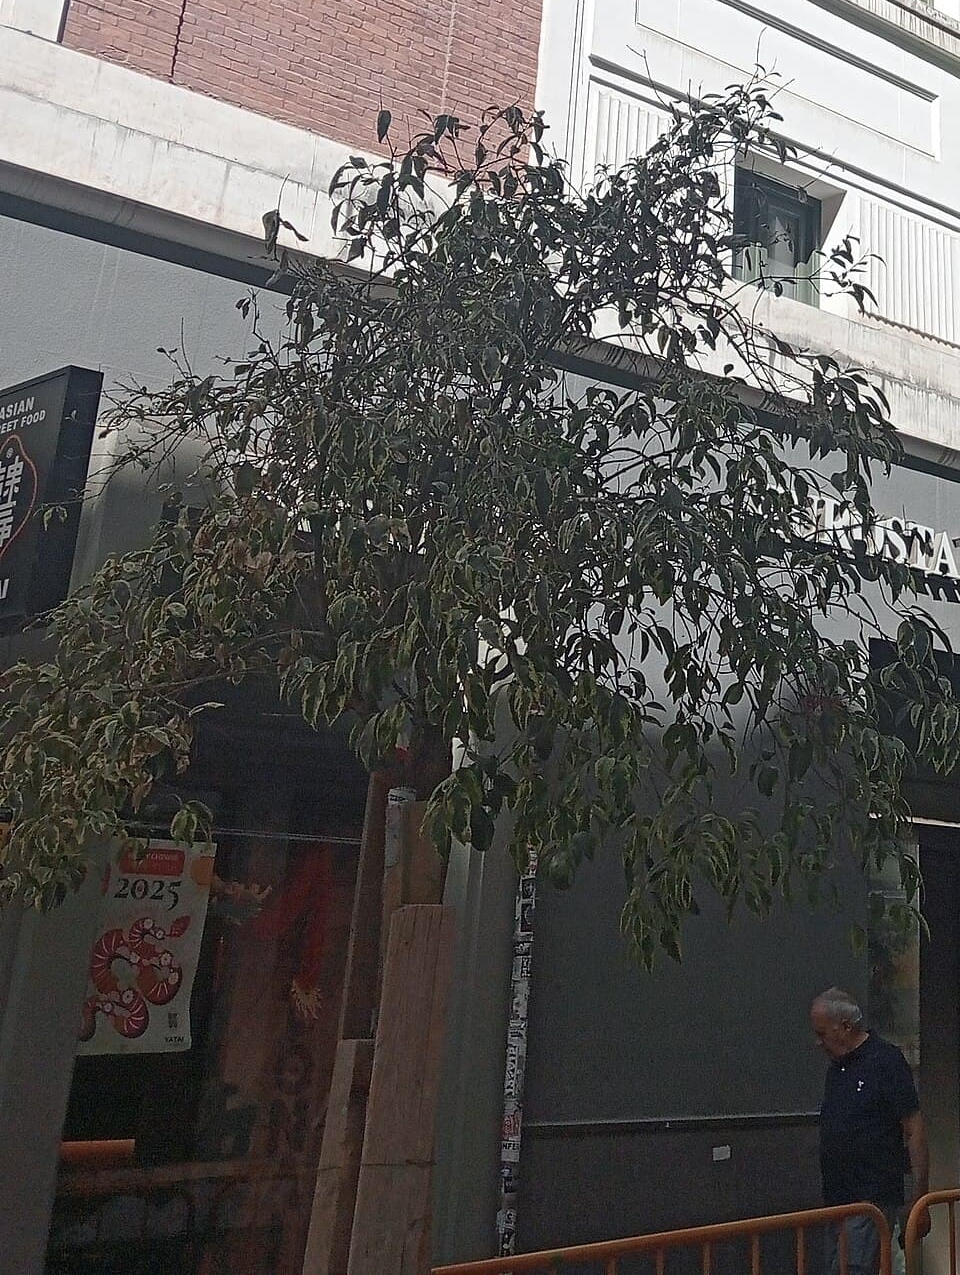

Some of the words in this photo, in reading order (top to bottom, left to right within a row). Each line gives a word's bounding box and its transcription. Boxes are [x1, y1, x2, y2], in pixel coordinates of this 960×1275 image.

[0, 419, 19, 434] EET
[21, 410, 46, 427] FOOD
[114, 878, 182, 911] 2025
